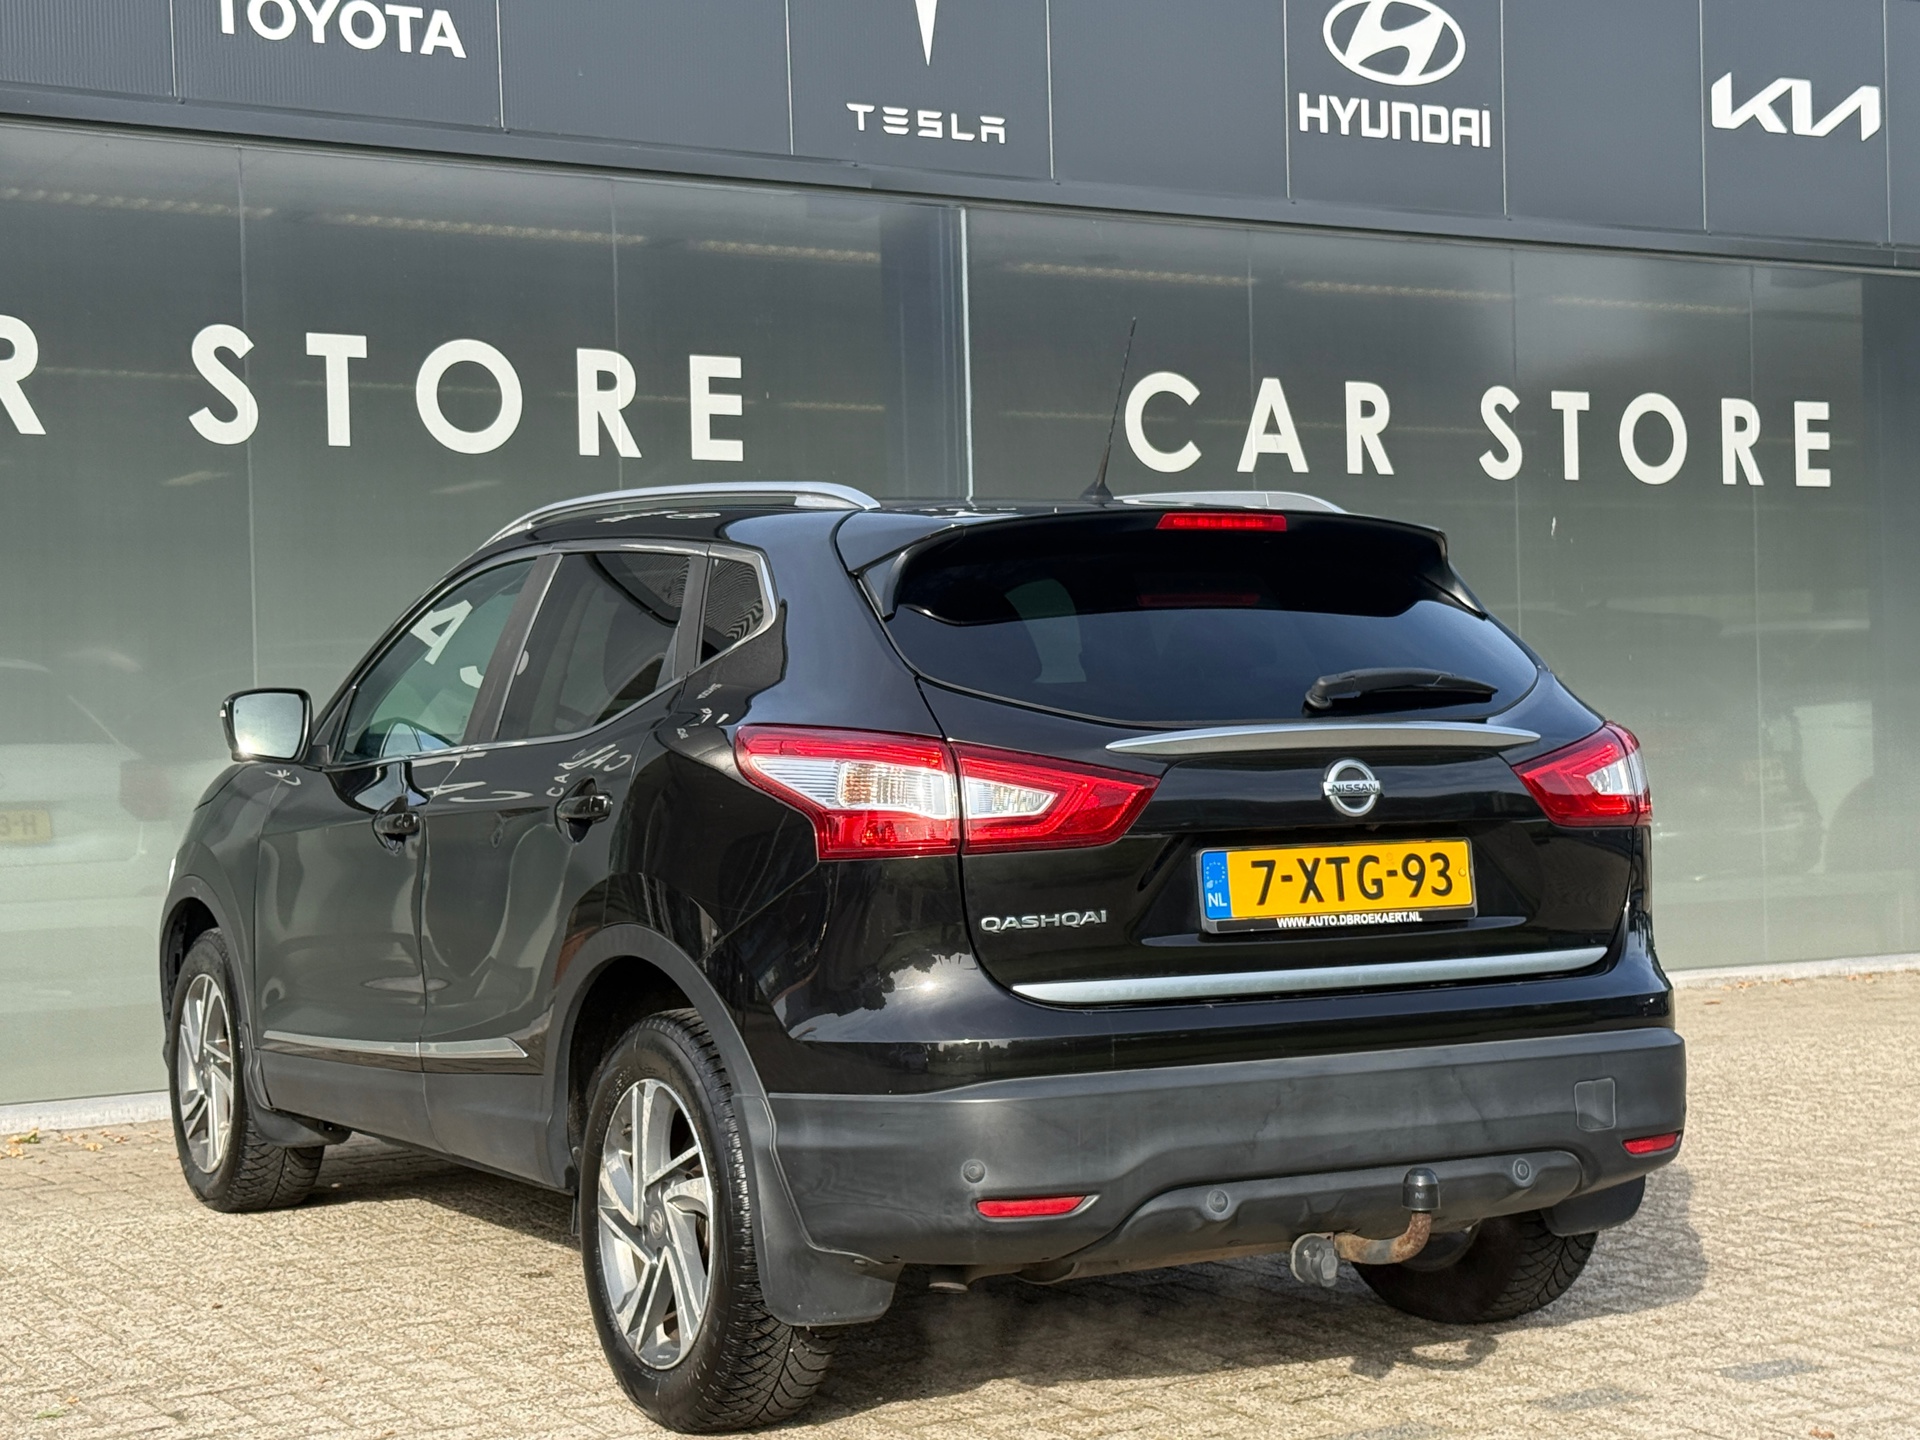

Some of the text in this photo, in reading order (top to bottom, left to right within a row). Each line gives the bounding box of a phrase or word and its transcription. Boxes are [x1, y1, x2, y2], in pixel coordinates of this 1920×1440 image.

[220, 0, 467, 59] TOYOTA
[846, 102, 1006, 144] TESLA
[1298, 92, 1491, 148] HYUNDAI
[1710, 71, 1882, 142] KIA
[0, 314, 744, 463] R STORE
[1124, 371, 1832, 488] CAR STORE
[1331, 783, 1377, 794] NISSAN
[1207, 891, 1229, 908] NL
[1251, 851, 1453, 906] 7-XTG-93
[980, 909, 1107, 934] QASHQAI
[1276, 911, 1423, 929] WWW.AUTO.DBROEKAERT.NL
